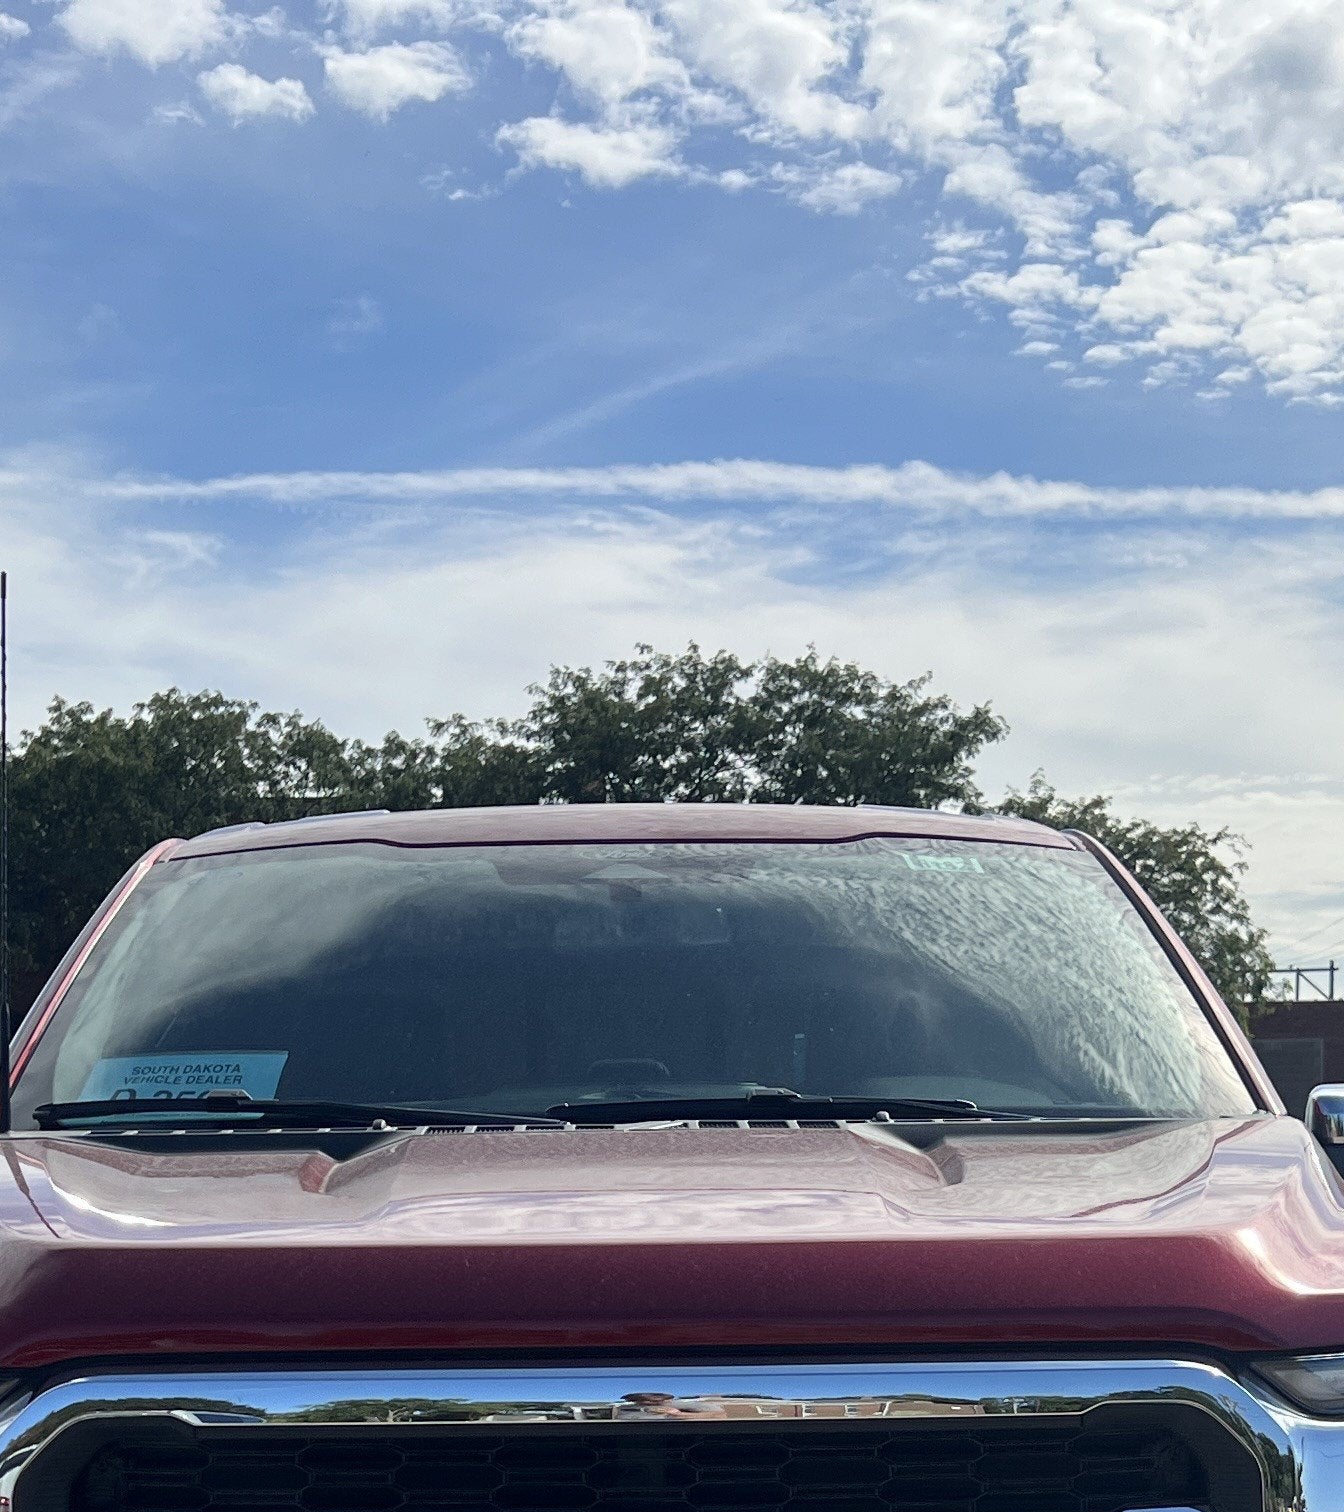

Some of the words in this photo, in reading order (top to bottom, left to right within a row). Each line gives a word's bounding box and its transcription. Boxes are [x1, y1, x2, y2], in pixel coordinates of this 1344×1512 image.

[131, 1066, 179, 1076] SOUTH
[183, 1064, 241, 1075] DAKOTA
[124, 1076, 182, 1085] VEHICLE
[185, 1075, 243, 1085] DEALER
